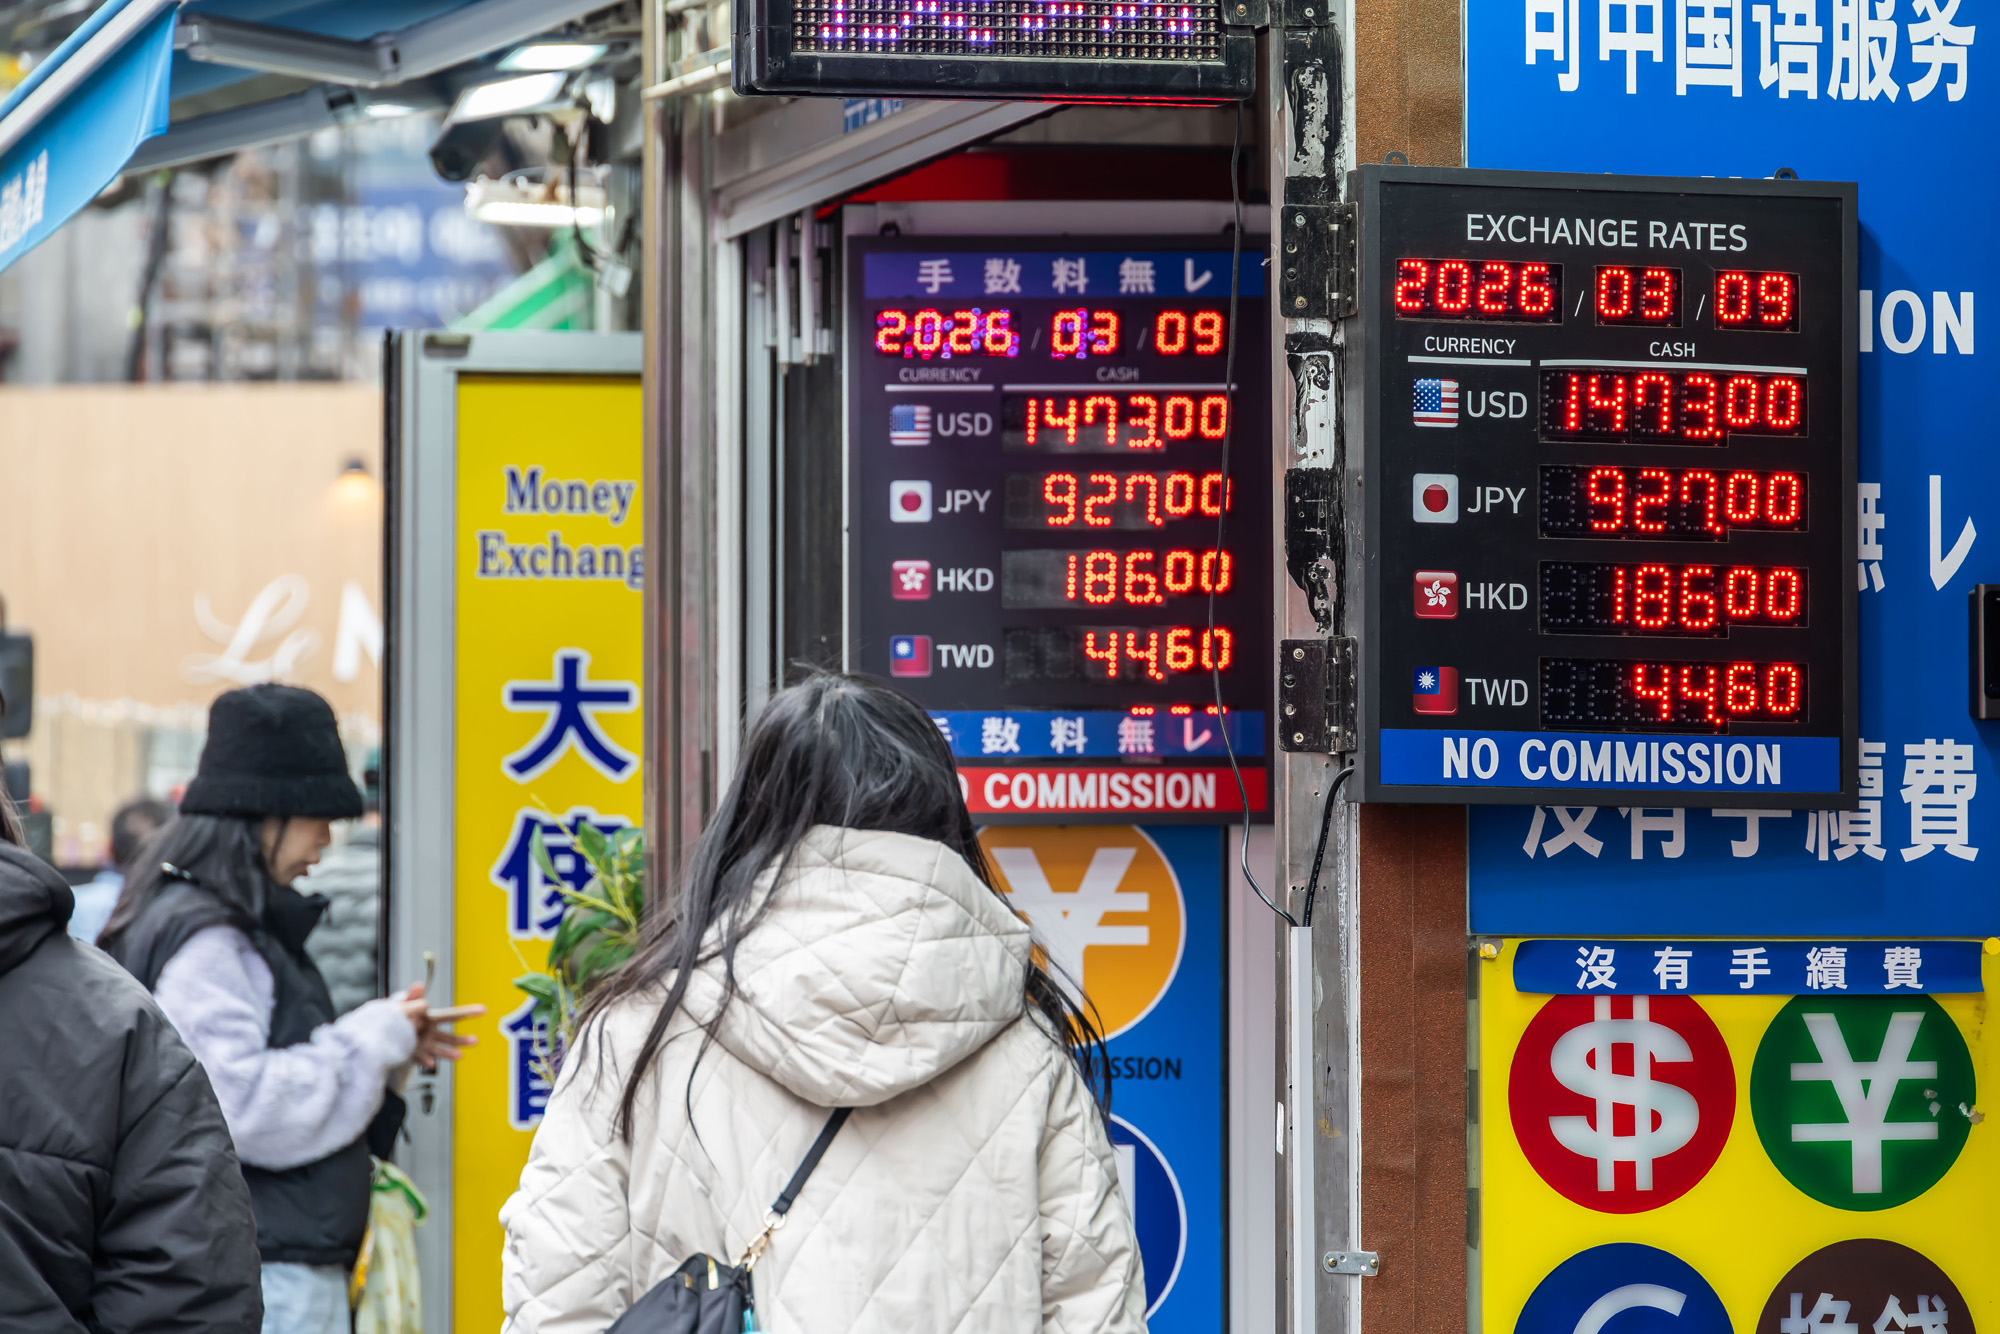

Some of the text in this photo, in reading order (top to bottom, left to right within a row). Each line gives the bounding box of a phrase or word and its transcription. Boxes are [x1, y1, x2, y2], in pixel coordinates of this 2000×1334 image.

[1525, 0, 1977, 103] 可中国语服务
[1466, 213, 1748, 252] EXCHANGE RATES
[1396, 260, 1551, 312] 2026
[1598, 268, 1671, 318] 03
[1717, 273, 1790, 322] 09
[876, 310, 1013, 354] 2026
[1052, 310, 1118, 354] 03
[1155, 310, 1223, 354] 09
[1424, 335, 1517, 356] CURRENCY
[1649, 341, 1697, 358] CASH
[898, 367, 982, 382] CURRENCY
[1096, 366, 1140, 381] CASH
[936, 395, 1229, 449] USD 1473.00
[1467, 373, 1798, 439] USD 1473.00
[504, 467, 637, 525] Money
[938, 472, 1231, 526] JPY 927.00
[1467, 469, 1798, 535] JPY 927.00
[936, 567, 995, 592] HKD
[1466, 582, 1529, 612] HKD
[936, 643, 995, 669] TWD
[1465, 664, 1798, 726] TWD 44.60
[1443, 736, 1782, 786] NO COMMISSION
[983, 772, 1217, 809] COMMISSION
[1575, 945, 1924, 991] 沒有手續費
